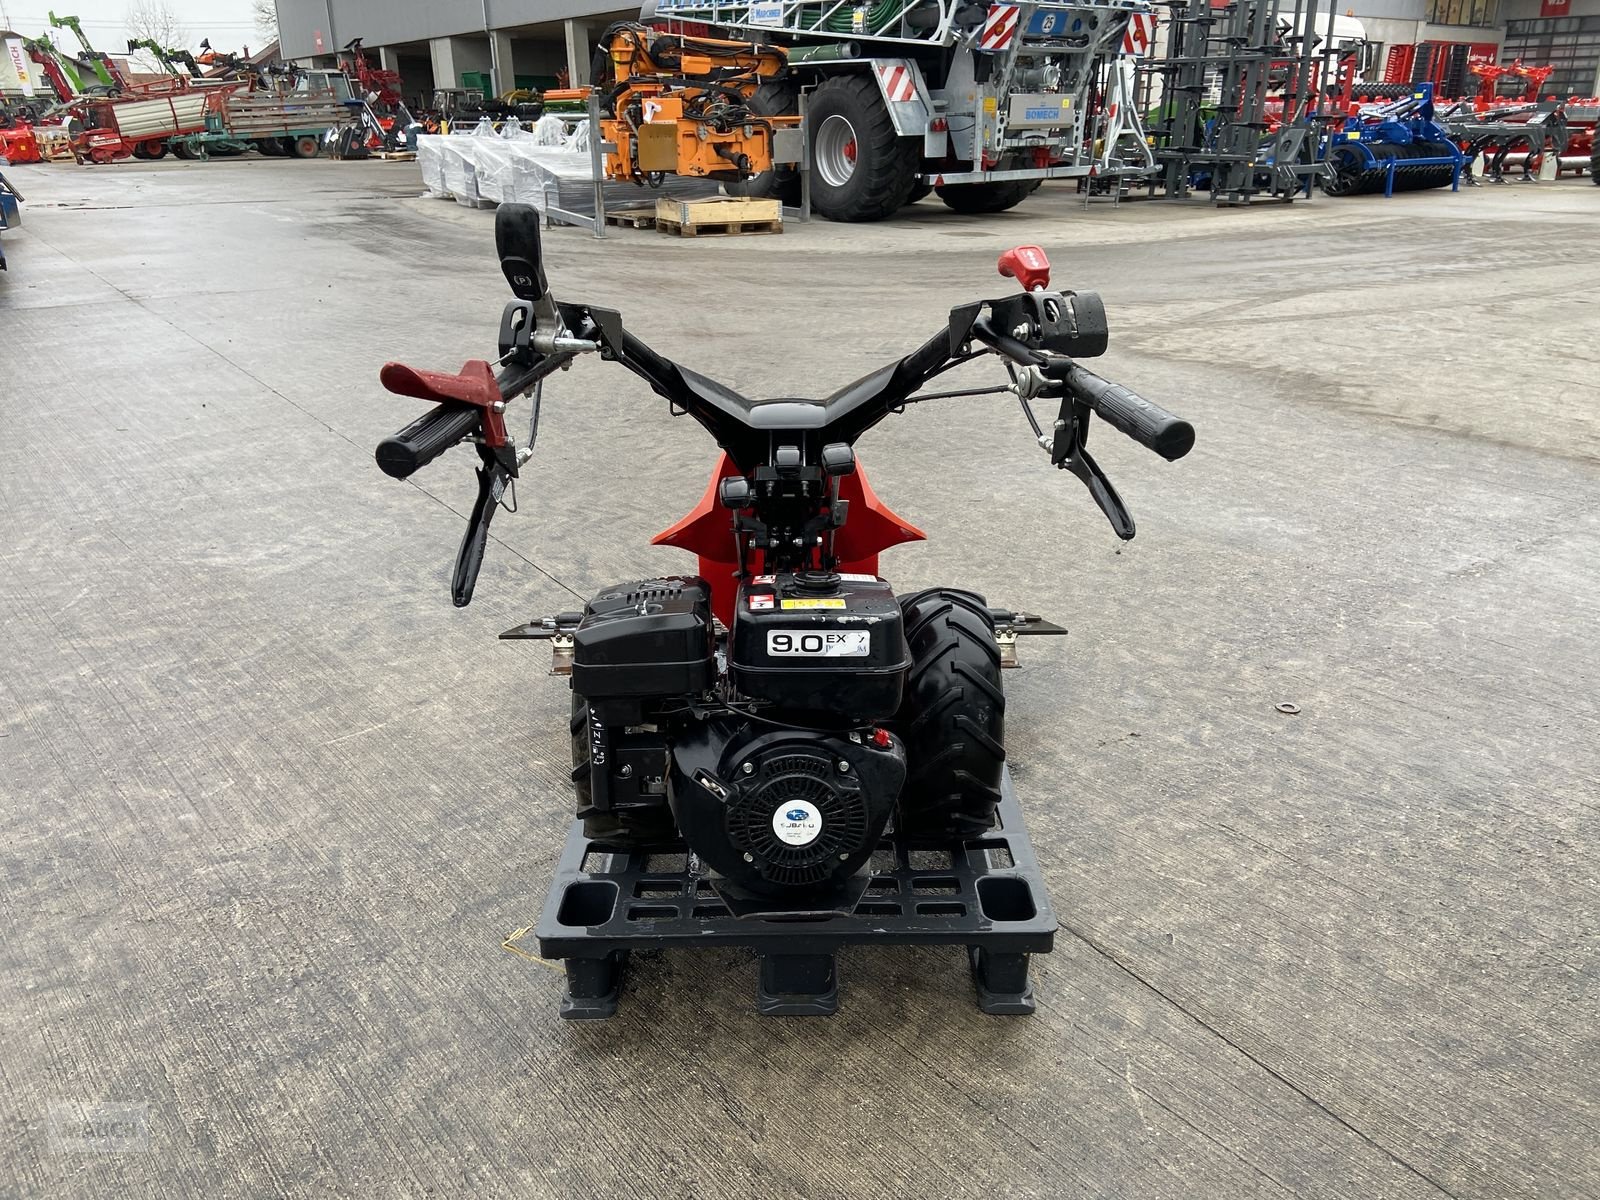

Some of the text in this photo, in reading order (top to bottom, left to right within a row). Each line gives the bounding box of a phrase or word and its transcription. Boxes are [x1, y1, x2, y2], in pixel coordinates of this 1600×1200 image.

[1043, 16, 1055, 29] 25
[1025, 110, 1059, 120] BOMECH
[771, 634, 824, 653] 9.0
